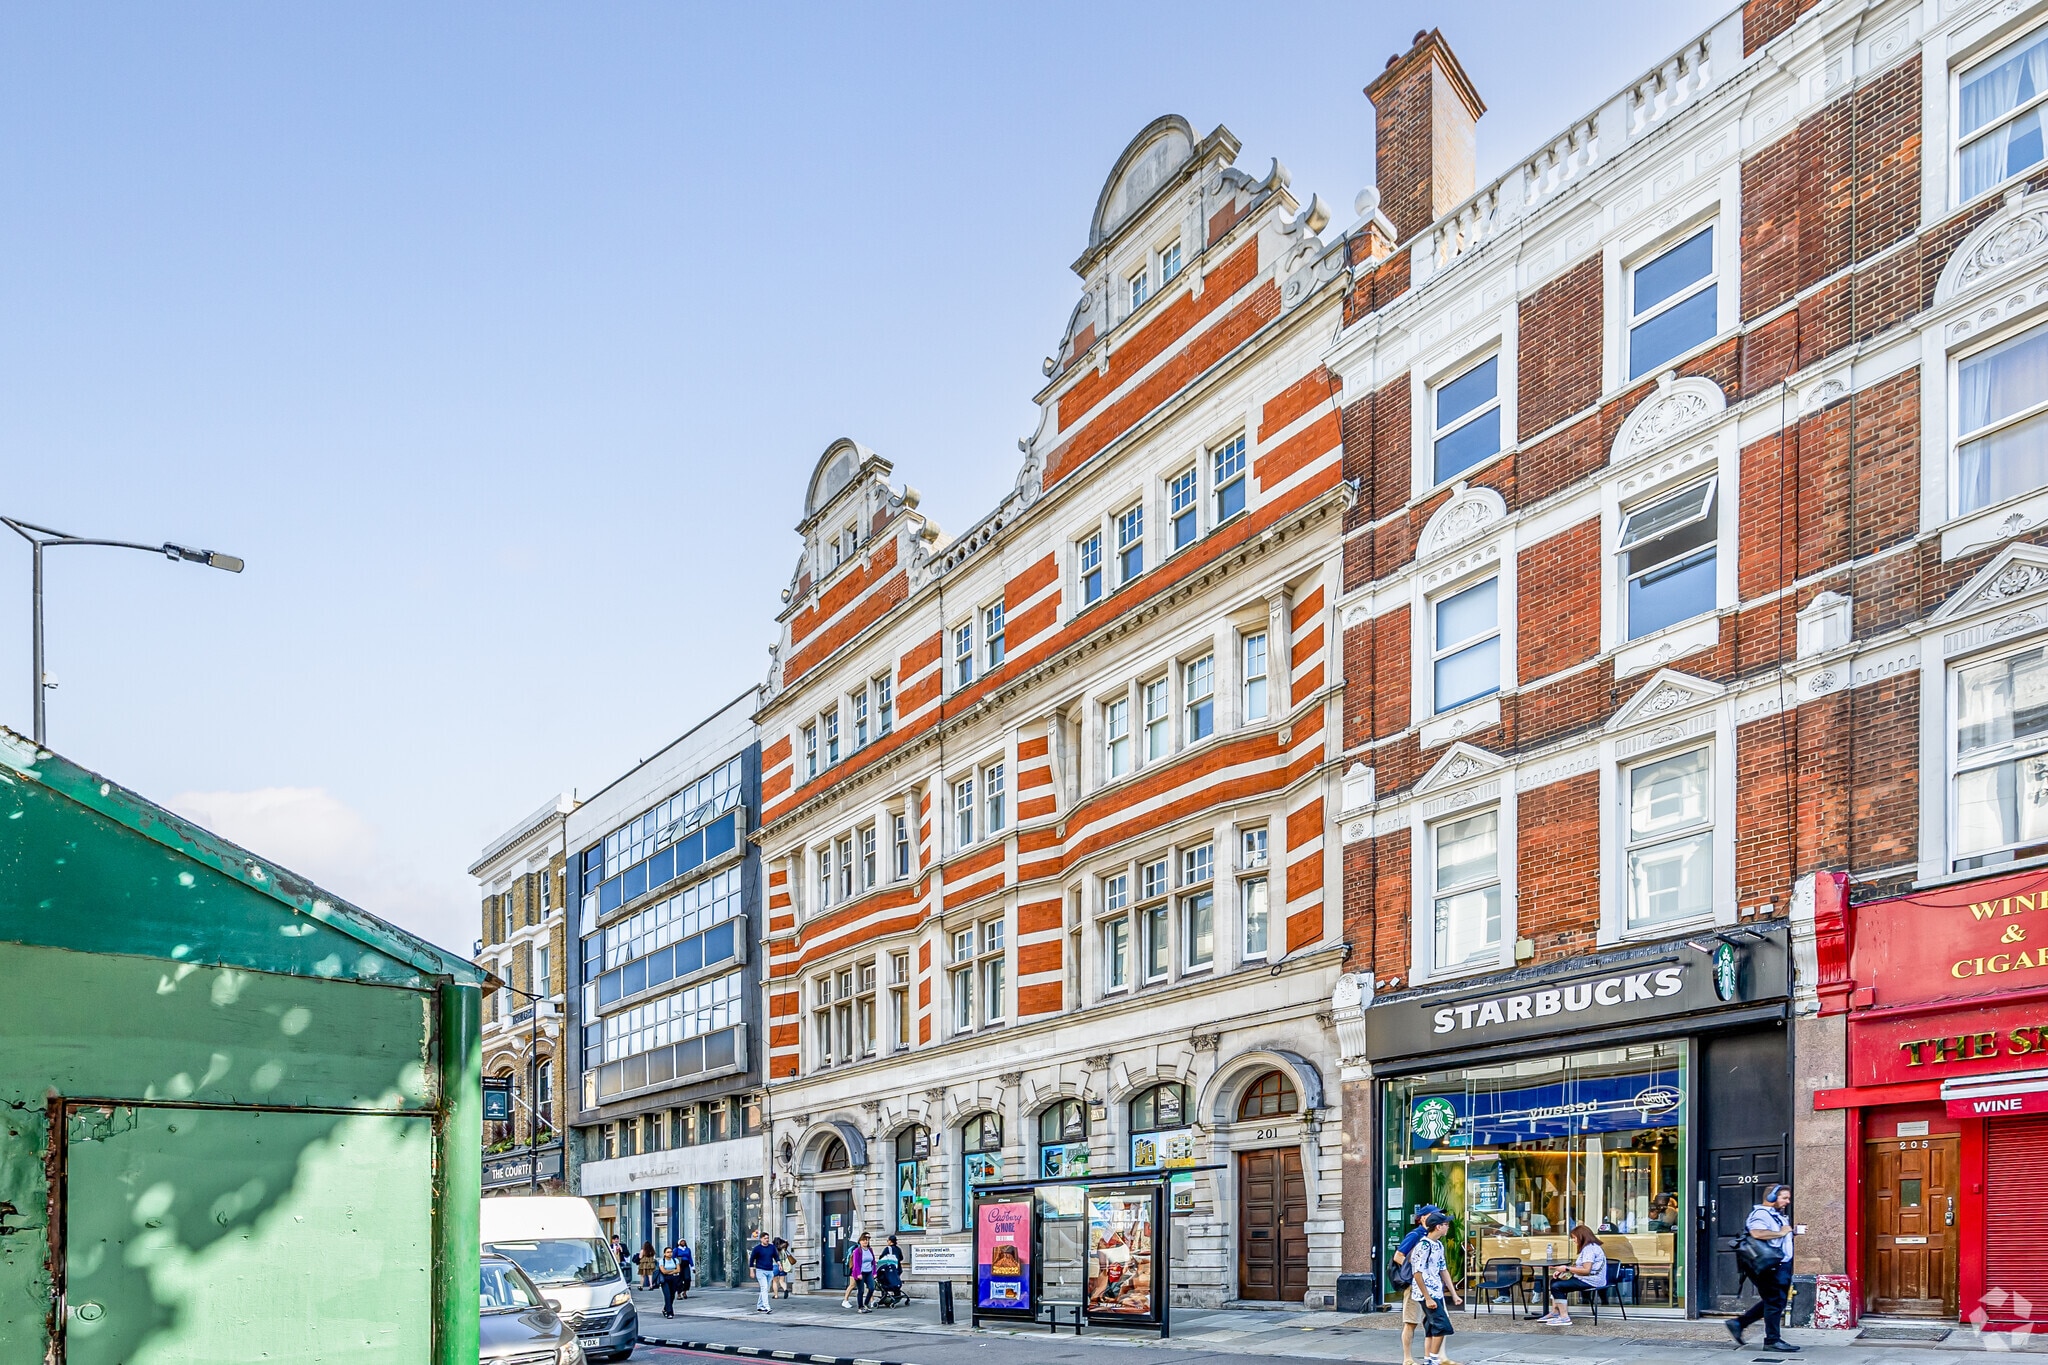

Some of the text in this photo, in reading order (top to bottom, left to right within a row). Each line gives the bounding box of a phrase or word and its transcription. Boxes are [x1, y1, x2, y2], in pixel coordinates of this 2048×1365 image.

[2001, 924, 2027, 944] &
[1434, 968, 1683, 1034] STARBUCKS
[1900, 1031, 1998, 1067] THE
[1973, 1098, 2022, 1113] WINE
[1257, 1128, 1278, 1139] 201
[1900, 1140, 1929, 1149] 205
[492, 1169, 504, 1179] THE
[1738, 1175, 1759, 1184] 203
[988, 1207, 1022, 1224] Cadbury
